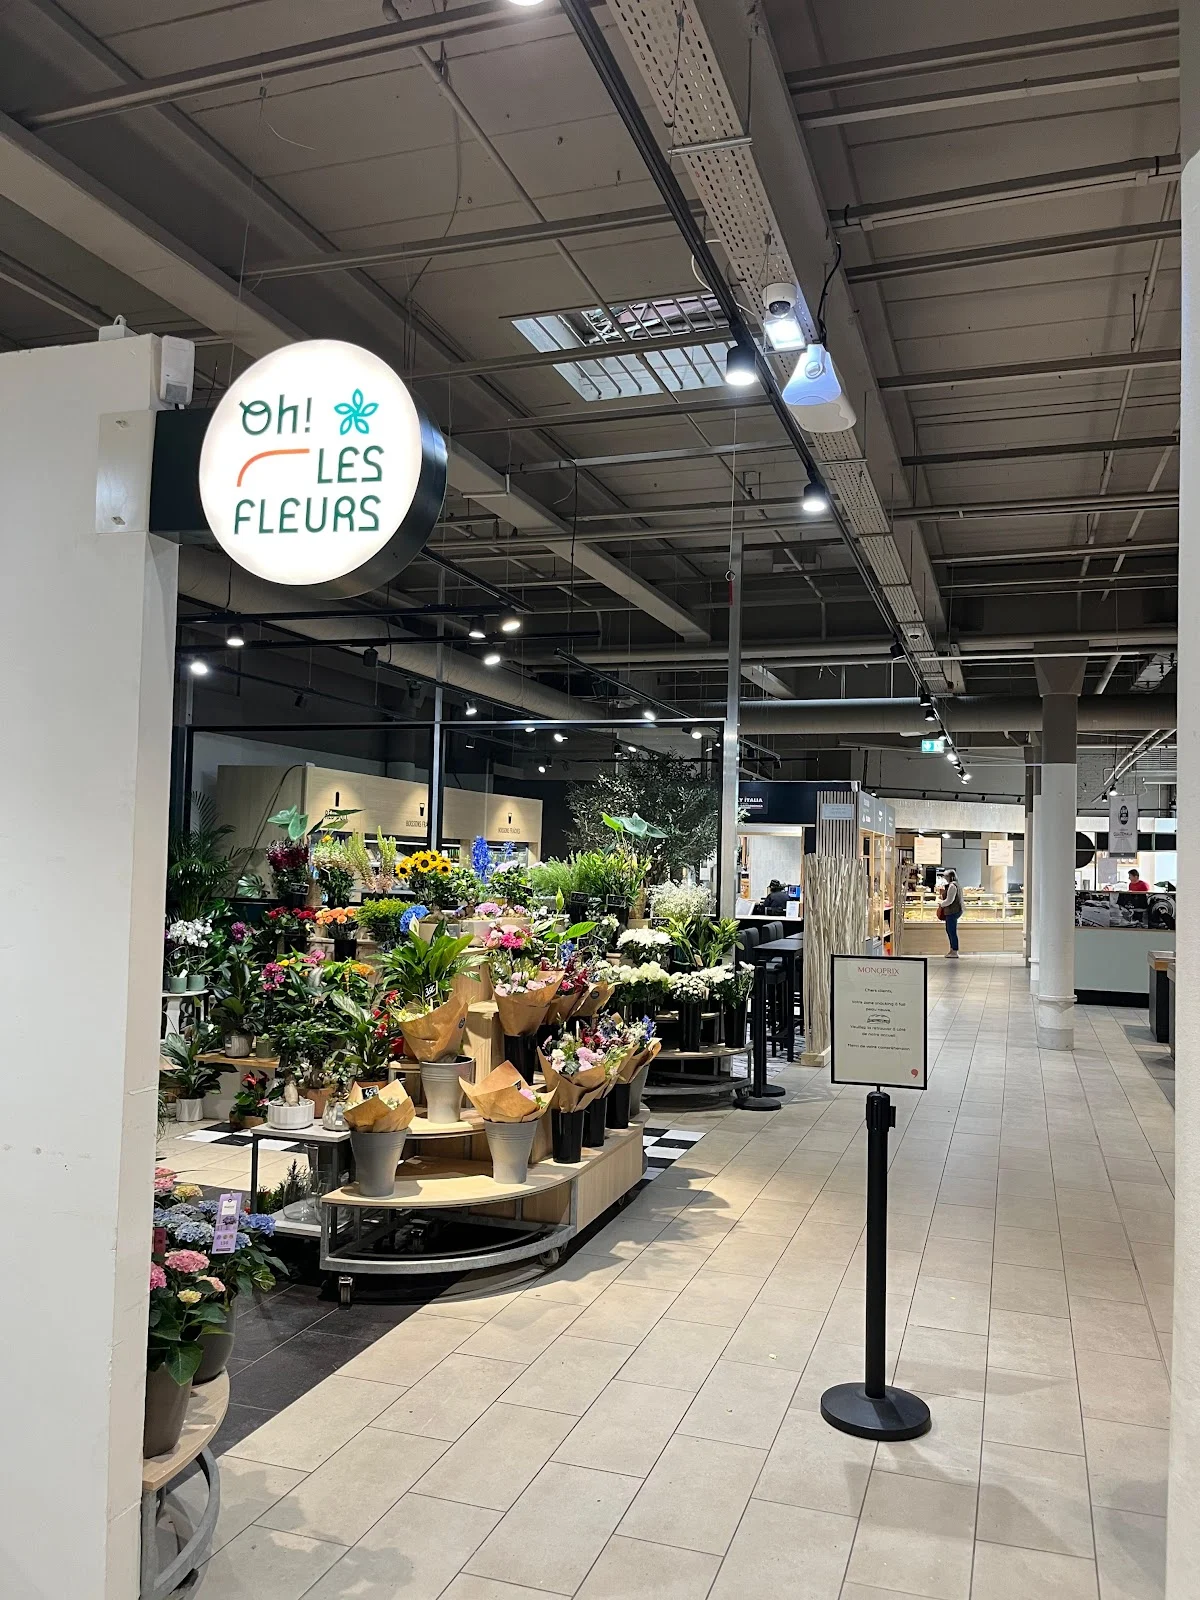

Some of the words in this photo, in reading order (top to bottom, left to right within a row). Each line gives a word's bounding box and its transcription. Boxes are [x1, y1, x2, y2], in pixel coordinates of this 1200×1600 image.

[239, 394, 312, 436] Oh!
[317, 445, 385, 484] LES
[234, 494, 382, 535] FLEURS
[857, 966, 900, 974] MONOPRIX
